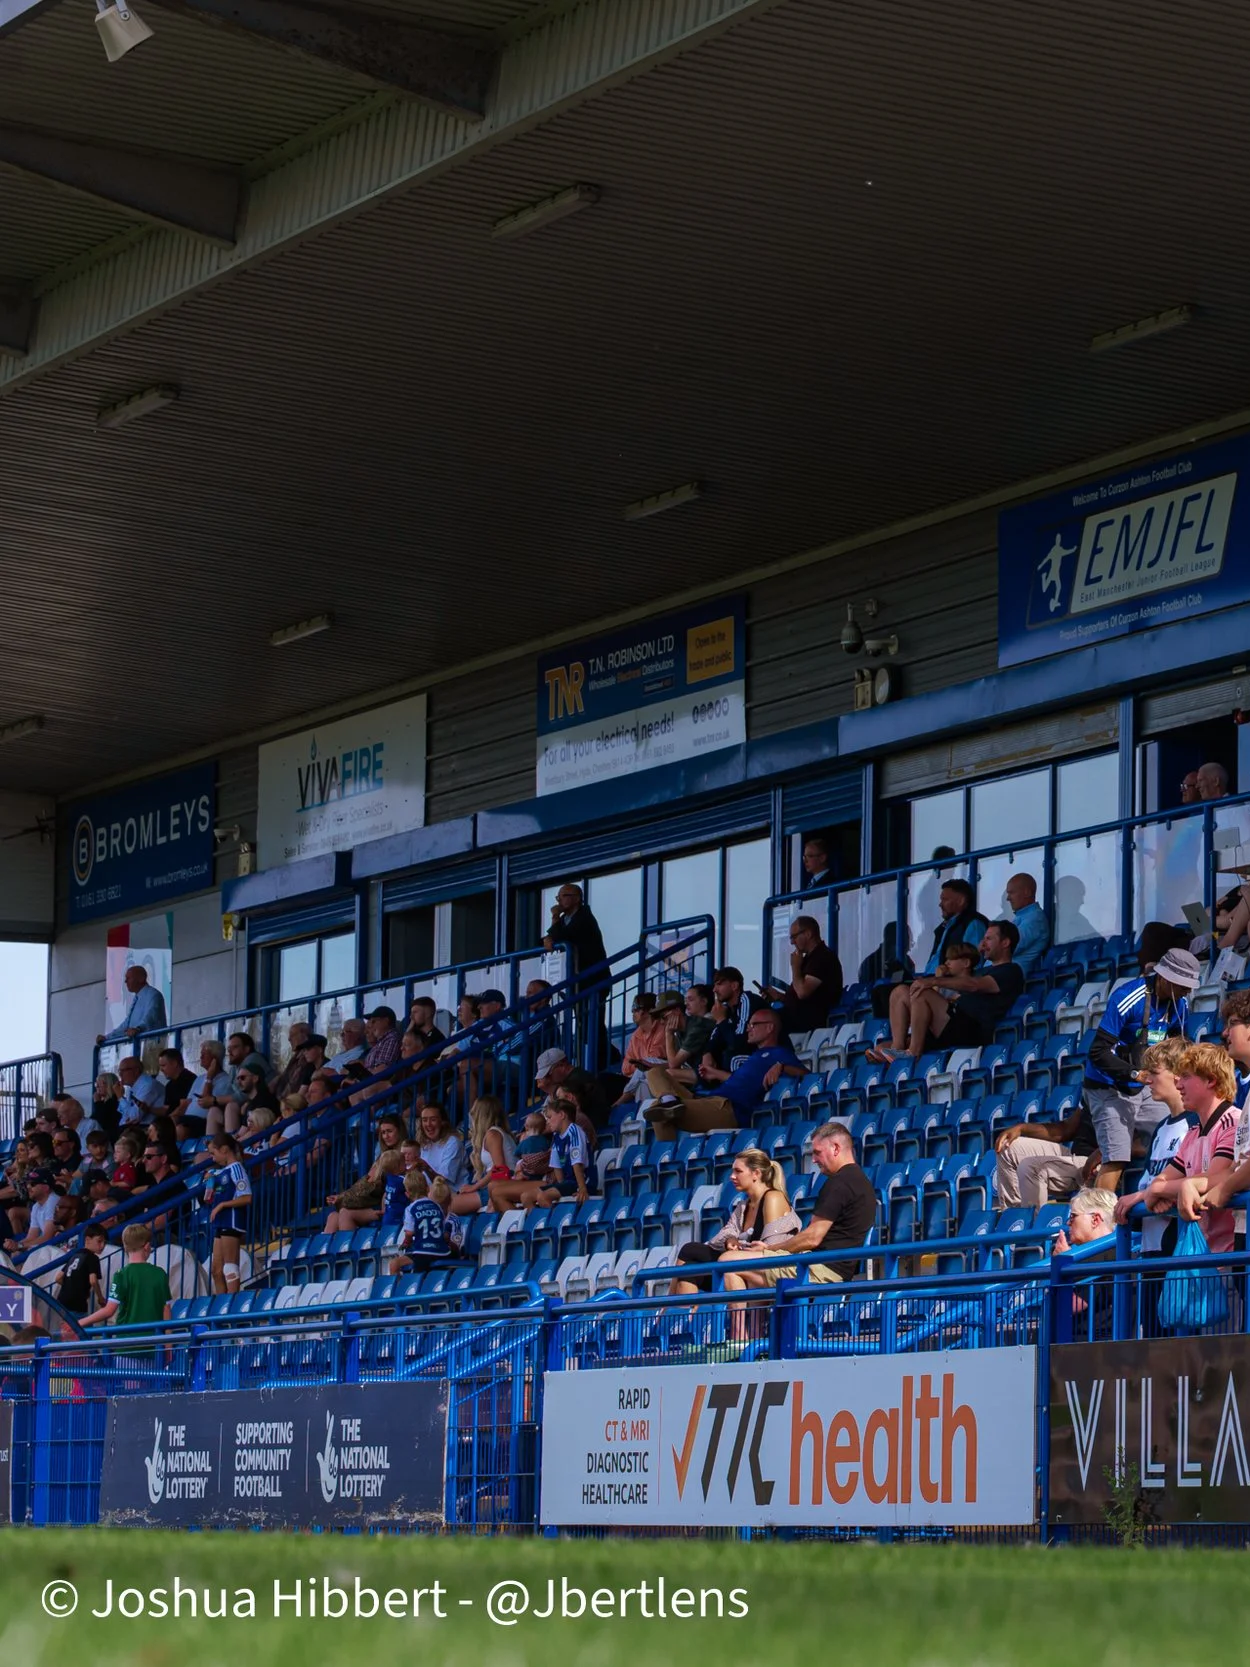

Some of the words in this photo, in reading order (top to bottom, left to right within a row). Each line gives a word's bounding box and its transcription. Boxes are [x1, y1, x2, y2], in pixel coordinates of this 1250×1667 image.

[1072, 491, 1099, 507] Welcome
[1100, 487, 1107, 499] To
[1108, 481, 1130, 496] Curzon
[1130, 474, 1151, 489] Ashton
[1152, 464, 1177, 481] Football
[1178, 461, 1192, 475] Club
[1084, 488, 1216, 587] EMJFL
[1080, 591, 1095, 603] East
[1097, 580, 1135, 599] Manchester
[1136, 573, 1158, 588] Junior
[1160, 562, 1188, 580] Football
[1190, 558, 1216, 573] League
[1077, 619, 1109, 639] Supporters
[1119, 610, 1139, 625] Curzon
[1140, 604, 1161, 618] Ashton
[1162, 598, 1187, 613] Football
[1188, 593, 1202, 606] Club
[588, 656, 605, 675] T.N.
[608, 640, 656, 670] ROBINSON
[657, 635, 675, 656] LTD
[642, 658, 675, 676] Distributors
[545, 661, 585, 721] TNR
[545, 747, 558, 766] For
[561, 740, 571, 763] all
[573, 737, 594, 764] your
[596, 721, 639, 753] electrical
[641, 711, 674, 740] needs!
[297, 742, 384, 810] VIVAFIRE
[96, 795, 210, 863] BROMLEYS
[79, 839, 88, 864] B
[418, 1217, 442, 1240] 13
[618, 1387, 650, 1409] RAPID
[168, 1425, 186, 1447] THE
[235, 1421, 294, 1445] SUPPORTING
[340, 1418, 362, 1442] THE
[605, 1420, 618, 1441] CT
[621, 1420, 628, 1441] &
[631, 1419, 650, 1441] MRI
[788, 1373, 978, 1506] health
[166, 1451, 212, 1473] NATIONAL
[234, 1448, 292, 1473] COMMUNITY
[339, 1446, 390, 1470] NATIONAL
[587, 1451, 649, 1473] DIAGNOSTIC
[165, 1477, 208, 1499] LOTTERY
[233, 1475, 282, 1498] FOOTBALL
[339, 1474, 386, 1498] LOTTERY
[582, 1483, 648, 1505] HEALTHCARE
